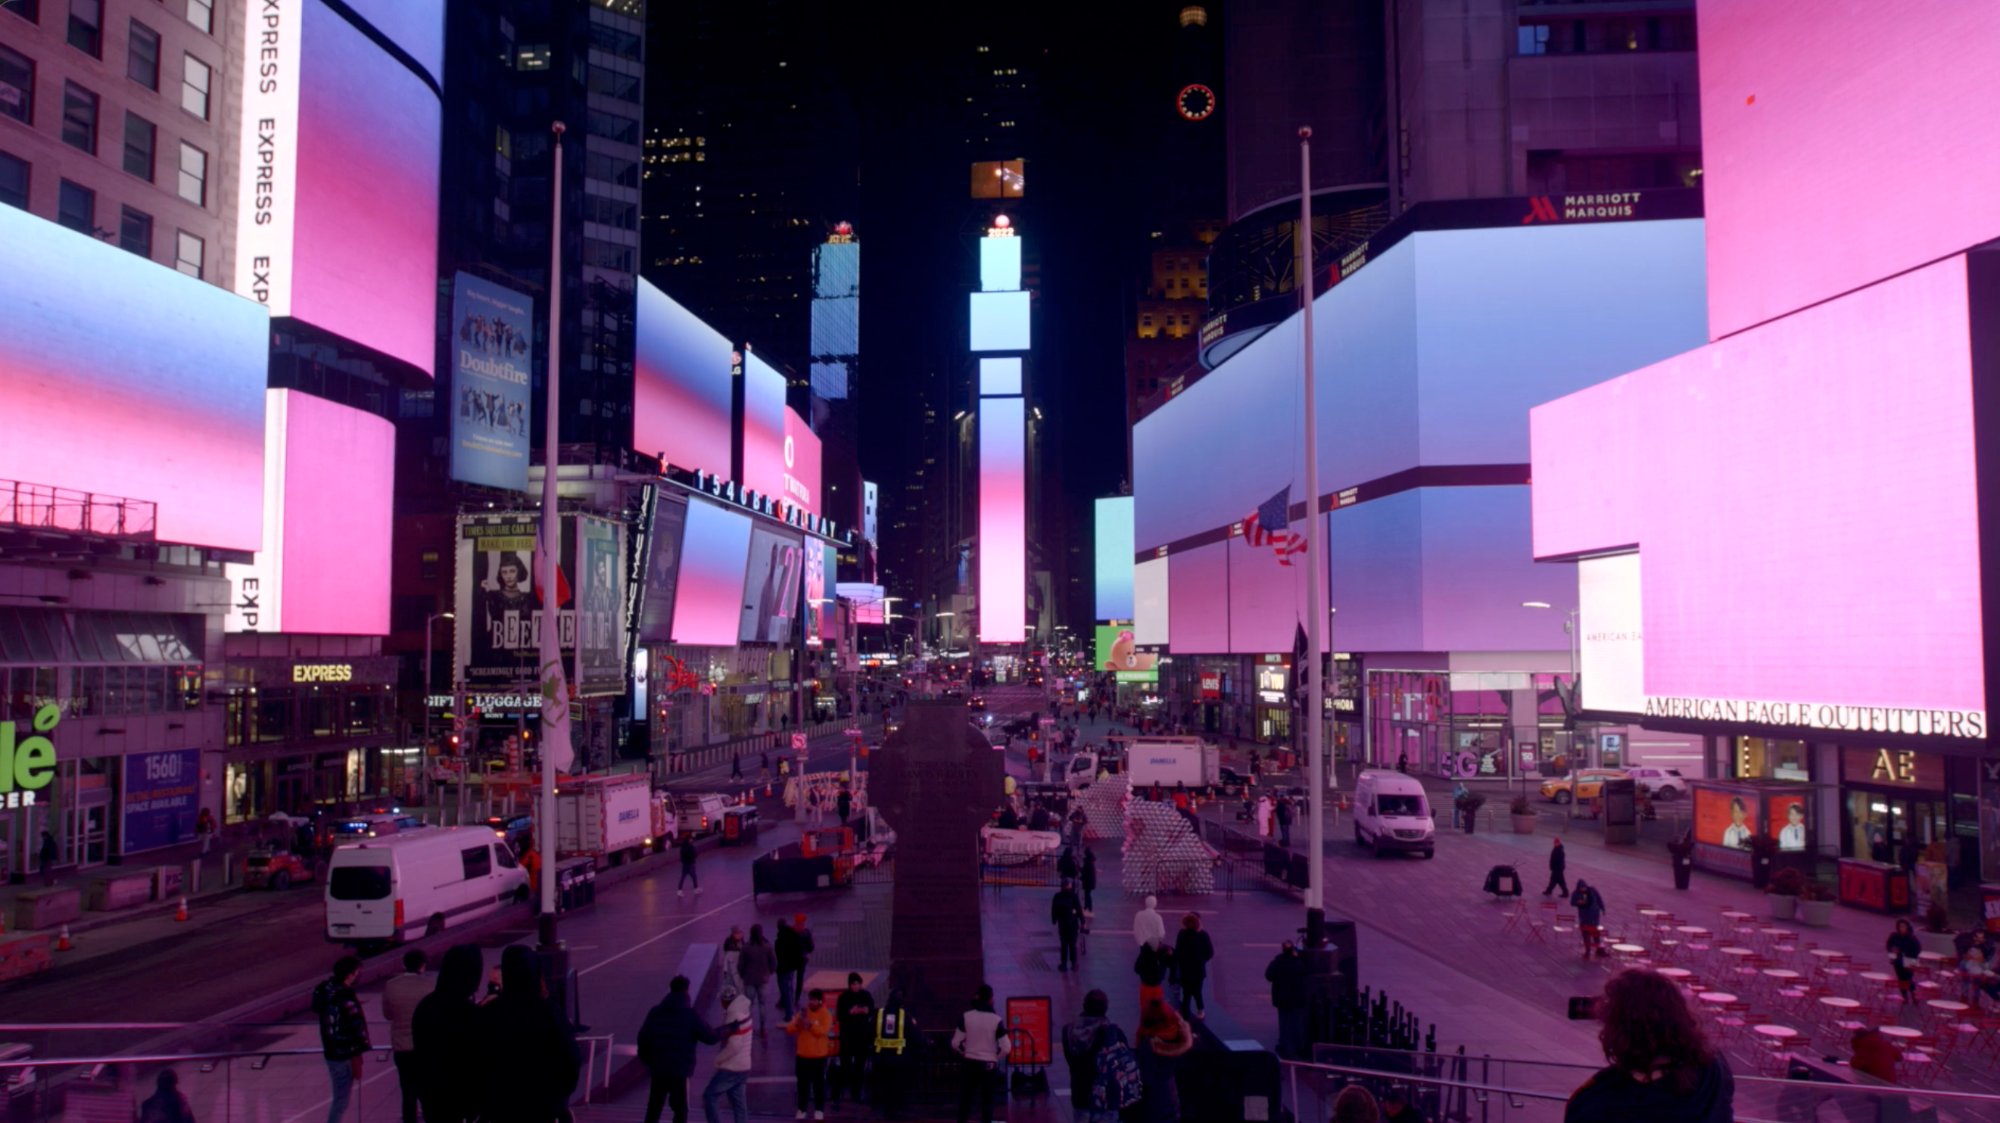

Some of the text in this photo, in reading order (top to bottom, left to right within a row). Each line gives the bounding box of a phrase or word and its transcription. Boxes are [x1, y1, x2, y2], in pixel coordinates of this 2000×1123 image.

[255, 117, 275, 226] EXPRESS
[1565, 192, 1641, 206] MARRIOTT
[1565, 205, 1633, 219] MARQUIS
[1341, 240, 1369, 266] MARRIOTT
[1341, 255, 1366, 277] MARQUIS
[460, 349, 528, 385] Doubtfire
[697, 470, 747, 506] 1540
[752, 487, 836, 538] BROADWAY
[485, 525, 510, 537] SQUARE
[511, 524, 525, 535] CAN
[632, 533, 644, 579] MAC
[242, 578, 259, 634] EXP
[625, 581, 637, 628] MAC
[491, 610, 576, 649] BEETE
[293, 664, 352, 682] EXPRESS
[475, 695, 543, 707] LUGGAGE
[1645, 696, 1984, 738] AMERICAN EAGLE OUTFITTERS
[144, 753, 177, 780] 1560
[1872, 747, 1916, 783] AE
[126, 795, 188, 814] SPACE AVAILABLE
